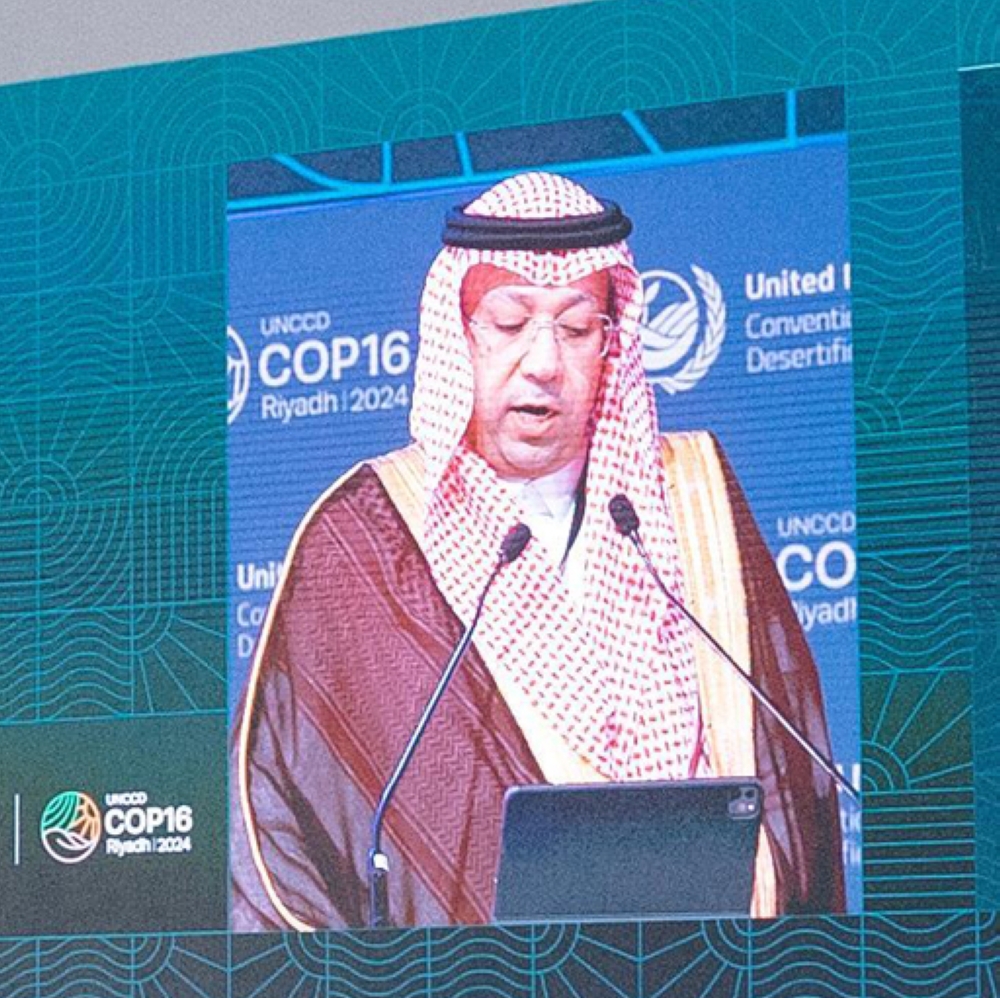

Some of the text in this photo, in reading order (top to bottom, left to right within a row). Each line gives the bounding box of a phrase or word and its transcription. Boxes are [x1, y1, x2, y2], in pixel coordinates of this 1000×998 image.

[745, 263, 835, 300] United
[260, 311, 331, 336] UNCCD
[258, 330, 411, 388] COP16
[261, 384, 408, 424] Riyadh 2024
[776, 510, 857, 537] UNCCD
[776, 540, 857, 591] CO
[105, 791, 147, 806] UNCCD
[104, 805, 193, 835] COP16
[106, 836, 192, 858] Riyadh 2024
